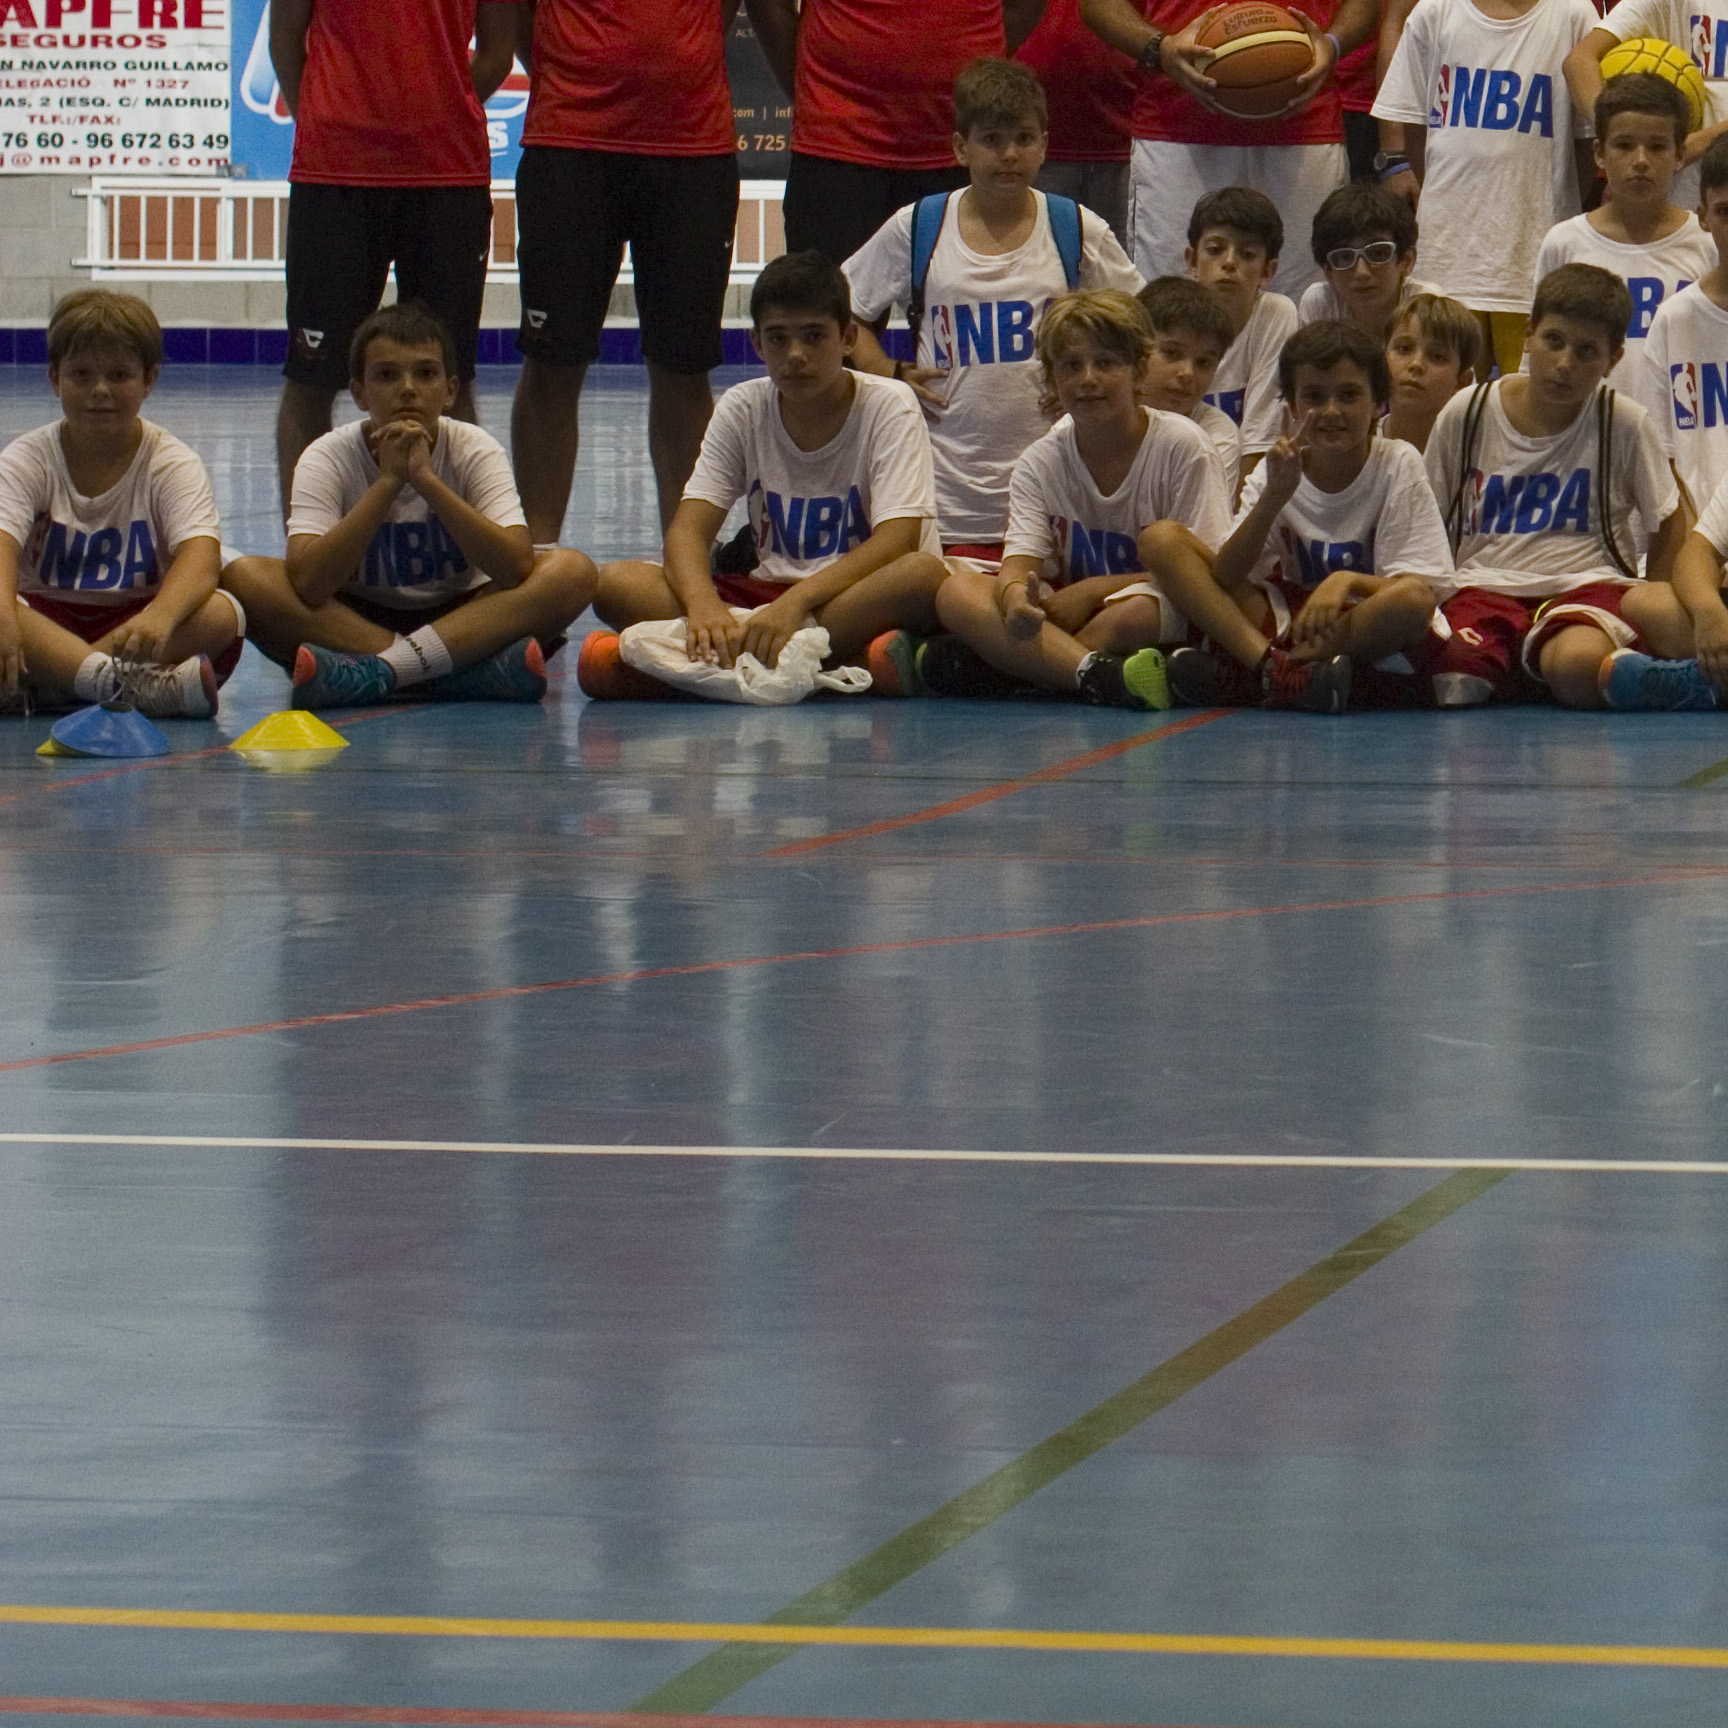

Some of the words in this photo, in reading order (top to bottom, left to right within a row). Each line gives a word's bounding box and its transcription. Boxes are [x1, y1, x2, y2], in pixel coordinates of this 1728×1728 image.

[21, 60, 117, 71] NAVARRO
[124, 60, 229, 71] GUILLAMO
[145, 78, 190, 89] 1327
[145, 96, 230, 110] MADRID)
[1450, 66, 1554, 138] NBA
[37, 132, 64, 149] 60
[86, 132, 114, 149] 96
[121, 132, 162, 149] 672
[168, 132, 195, 149] 63
[202, 132, 229, 149] 49
[767, 484, 872, 560] NBA
[1479, 467, 1591, 535] NBA
[43, 520, 158, 590] NBA
[364, 515, 468, 587] NBA
